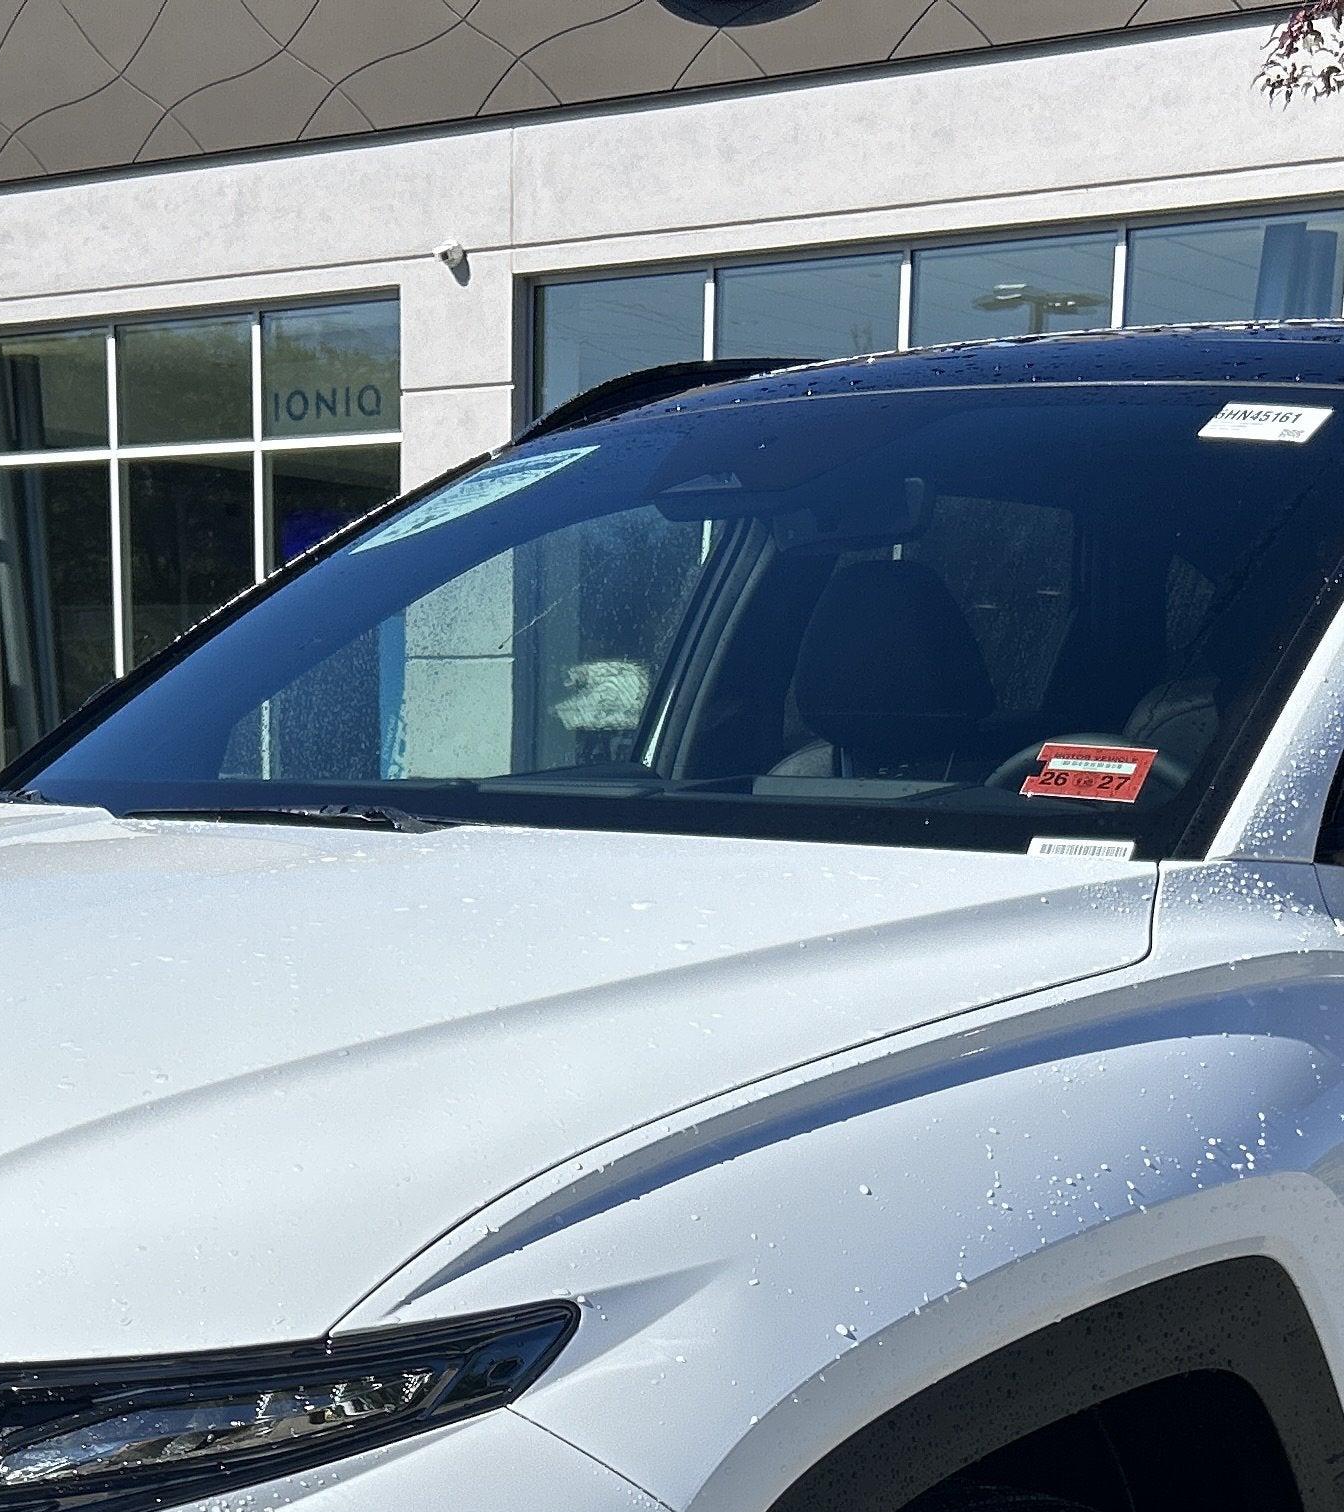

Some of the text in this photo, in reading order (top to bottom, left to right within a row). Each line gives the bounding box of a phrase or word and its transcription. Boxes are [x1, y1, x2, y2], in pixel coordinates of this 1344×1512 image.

[273, 384, 382, 422] IONIQ
[1038, 771, 1069, 786] 26
[1096, 775, 1131, 791] 27
